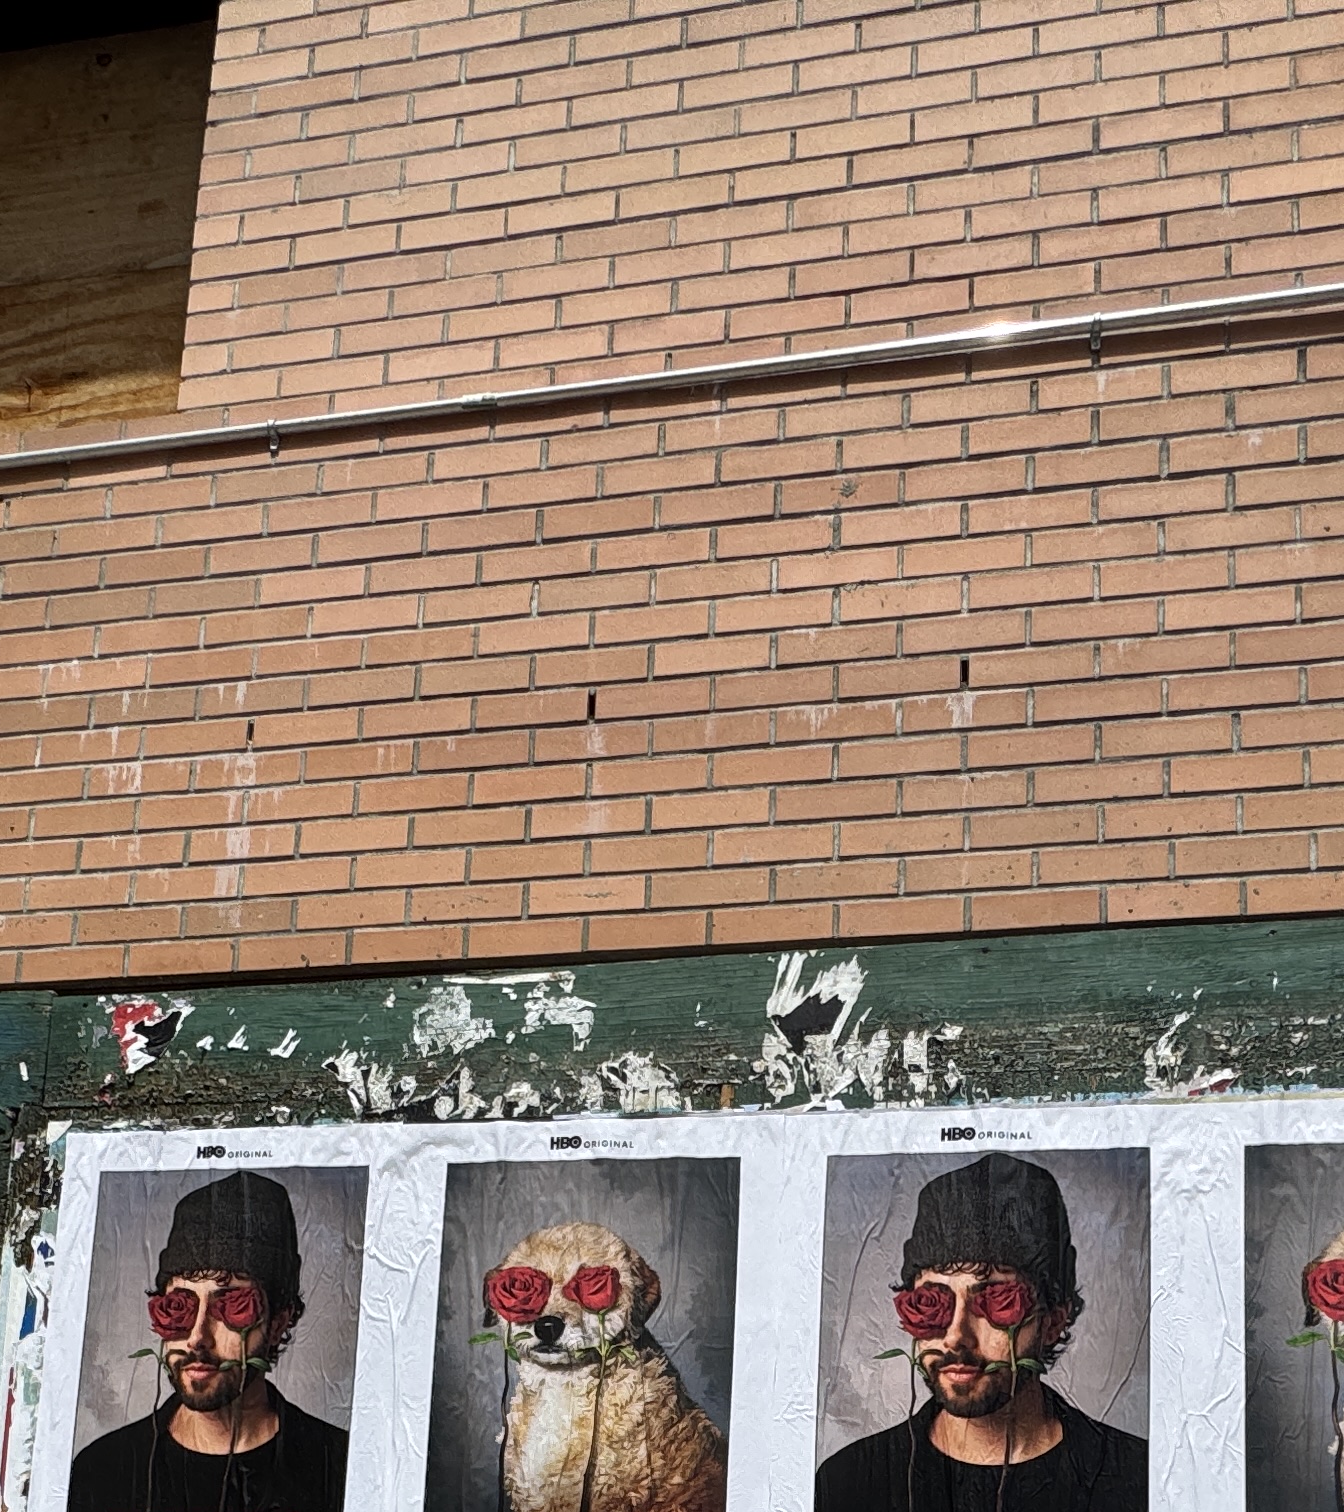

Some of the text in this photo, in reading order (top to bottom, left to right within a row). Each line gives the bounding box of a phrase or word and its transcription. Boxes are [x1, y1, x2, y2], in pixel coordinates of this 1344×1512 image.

[941, 1127, 1032, 1142] HBO ORIGINAL
[550, 1136, 634, 1150] HBO ORIGINAL
[197, 1146, 273, 1159] HBO ORIGINAL
